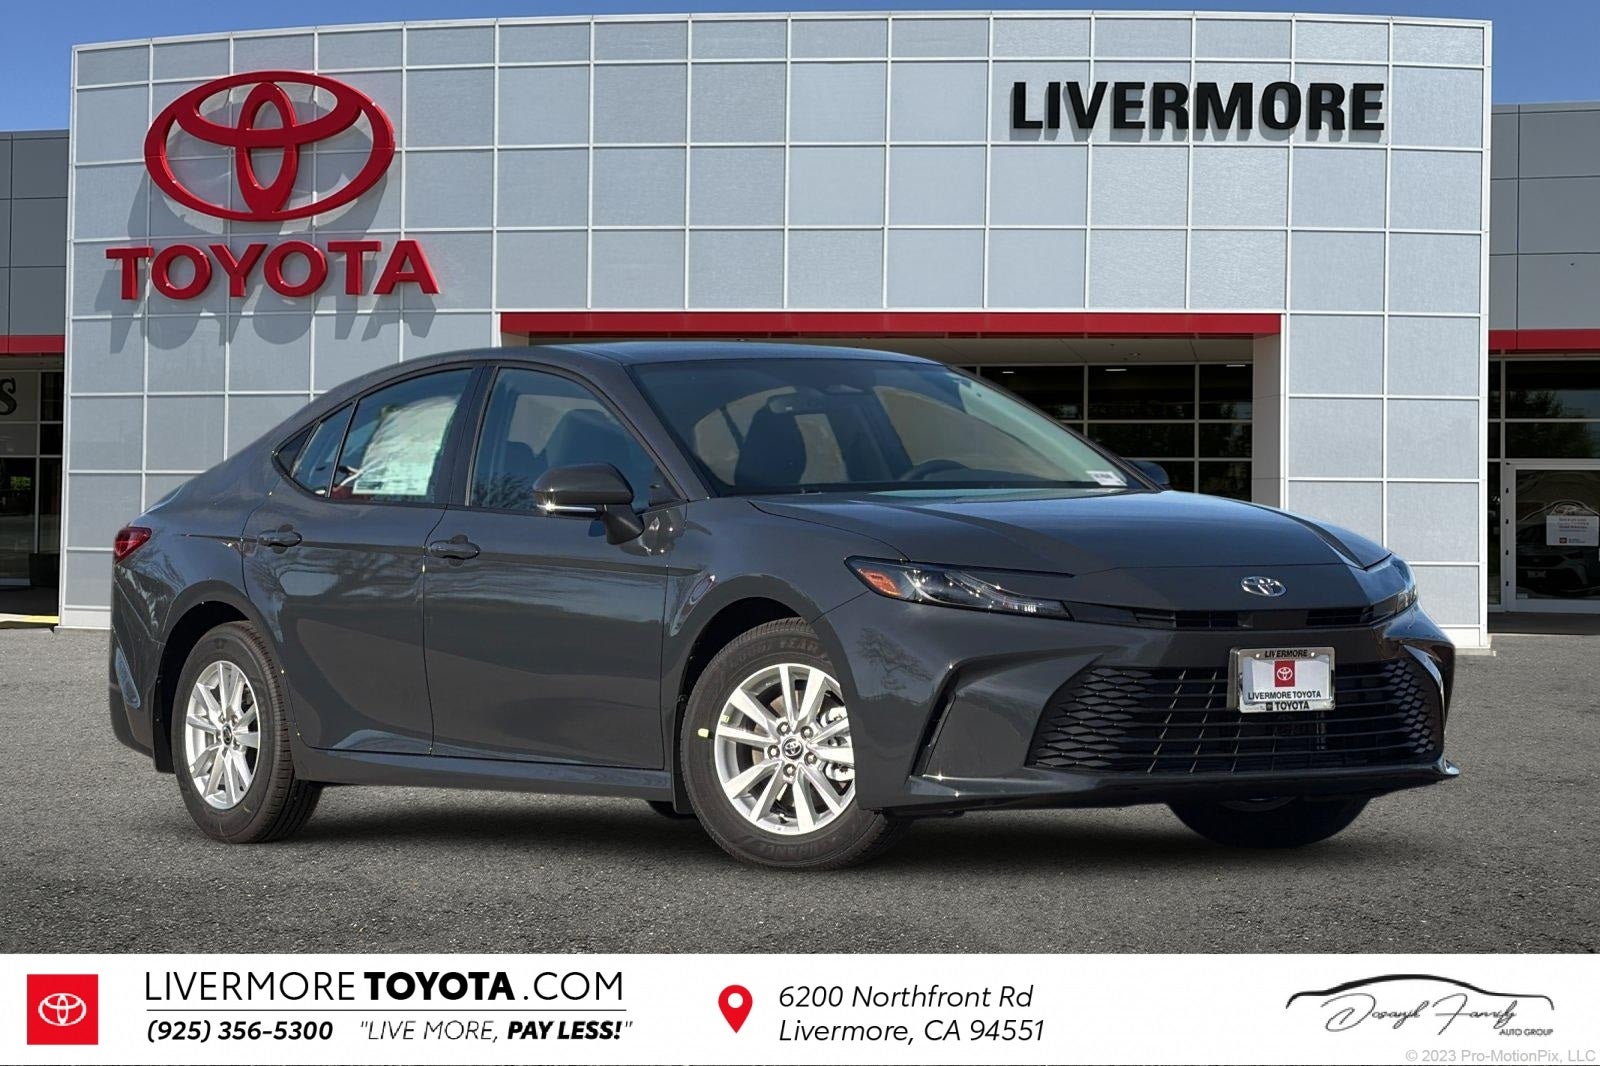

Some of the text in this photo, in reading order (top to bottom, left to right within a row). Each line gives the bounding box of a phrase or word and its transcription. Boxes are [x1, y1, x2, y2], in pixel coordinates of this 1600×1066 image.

[1011, 81, 1385, 131] LIVERMORE
[105, 240, 440, 300] TOYOTA
[1264, 649, 1308, 658] LIVERMORE
[1248, 690, 1322, 700] LIVERMORE TOYOTA
[1275, 700, 1310, 711] TOYOTA
